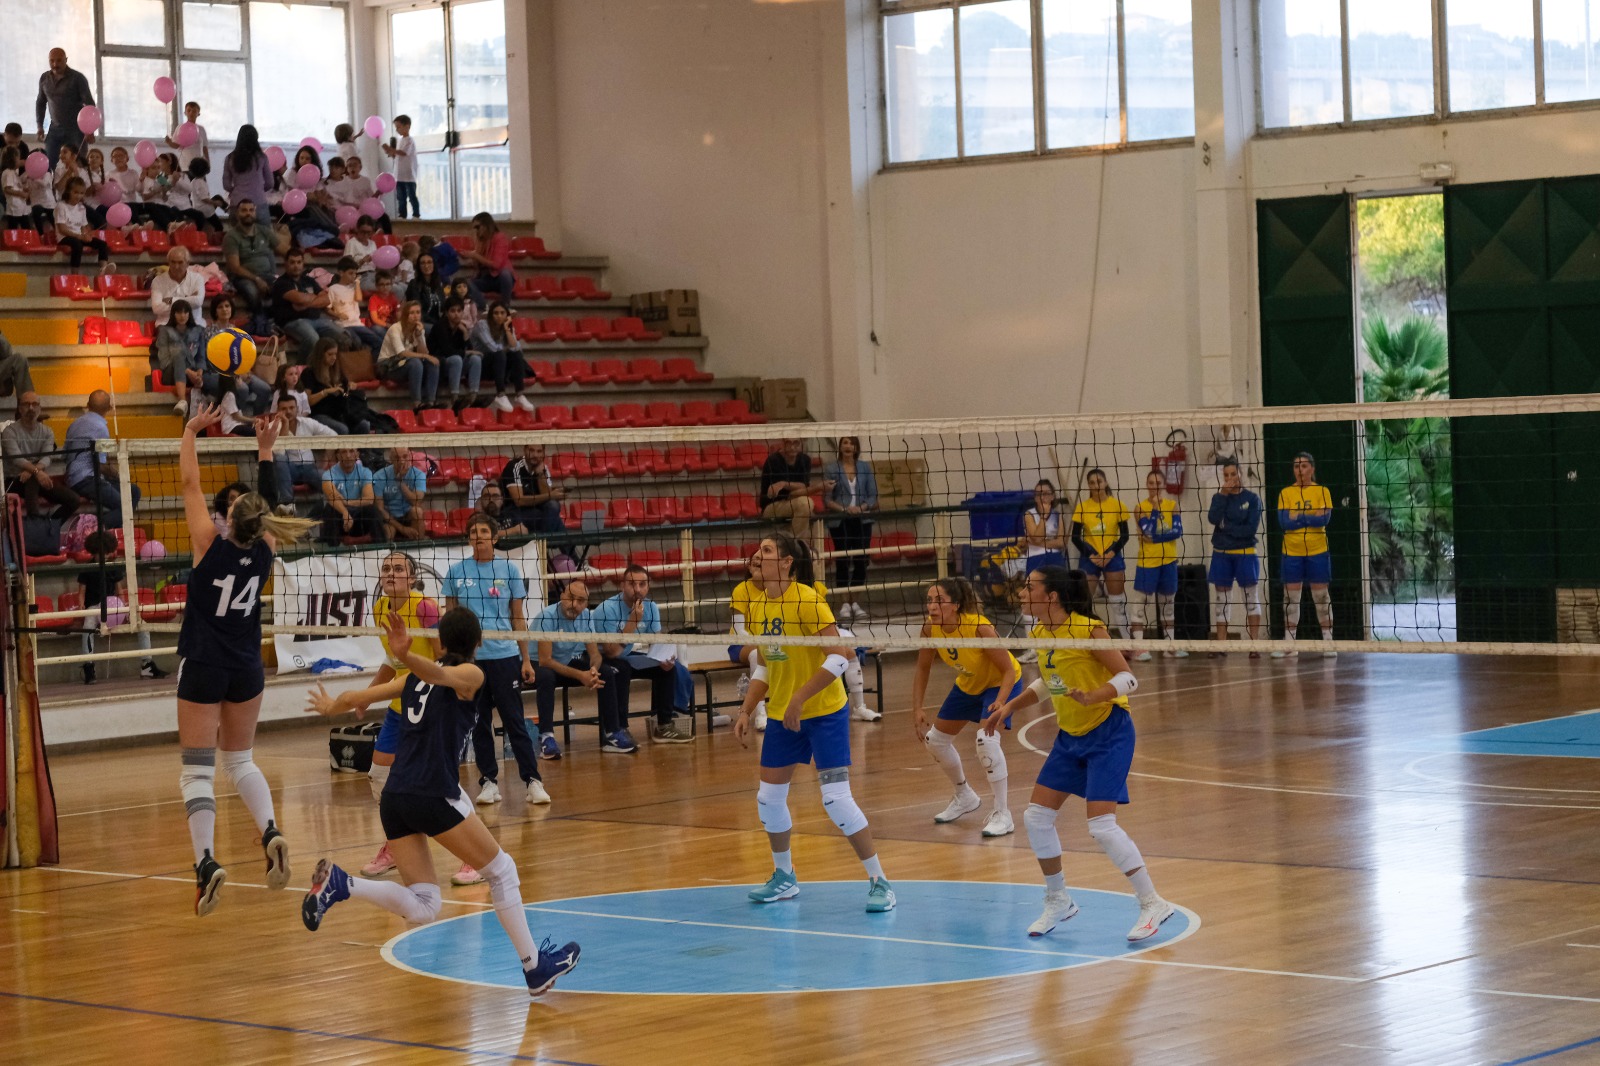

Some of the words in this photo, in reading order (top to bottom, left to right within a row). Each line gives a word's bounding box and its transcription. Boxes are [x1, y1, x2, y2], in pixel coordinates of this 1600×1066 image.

[212, 574, 260, 617] 14
[293, 590, 368, 642] JUST
[760, 617, 783, 636] 18
[407, 680, 435, 724] 3
